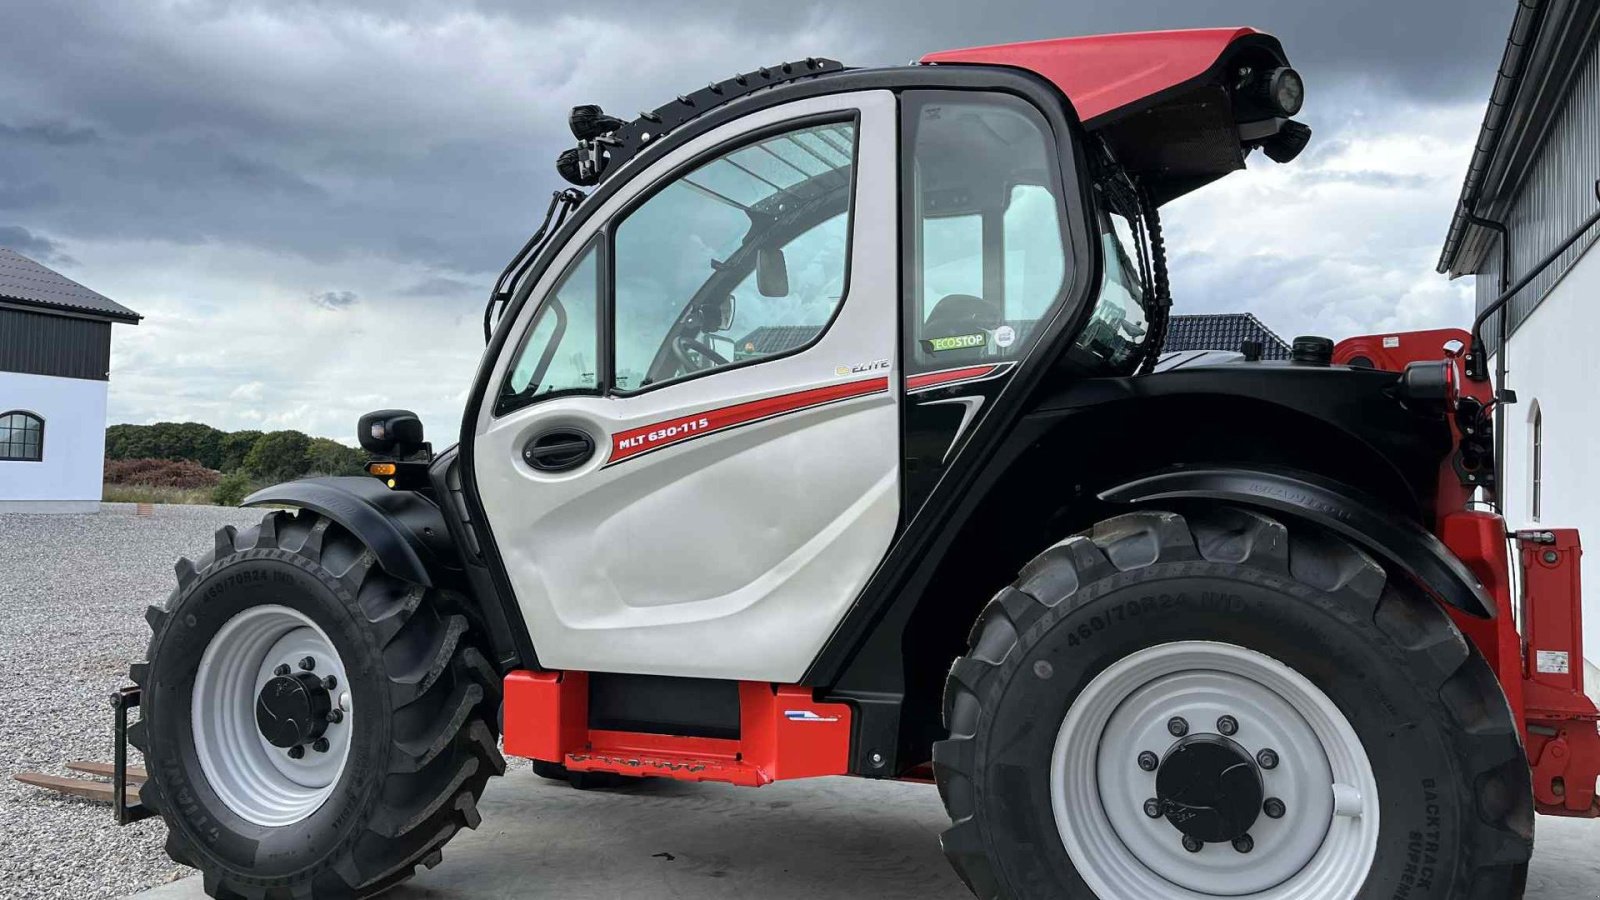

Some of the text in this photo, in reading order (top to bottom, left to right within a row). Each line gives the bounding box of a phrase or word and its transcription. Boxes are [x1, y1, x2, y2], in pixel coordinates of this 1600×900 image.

[935, 334, 983, 349] ECOSTOP
[851, 360, 890, 373] ELITE
[619, 418, 709, 450] MLT 630-115
[203, 569, 269, 602] 460/70R24
[1067, 592, 1188, 648] 460/70R24
[1416, 777, 1441, 892] BACKTRACK
